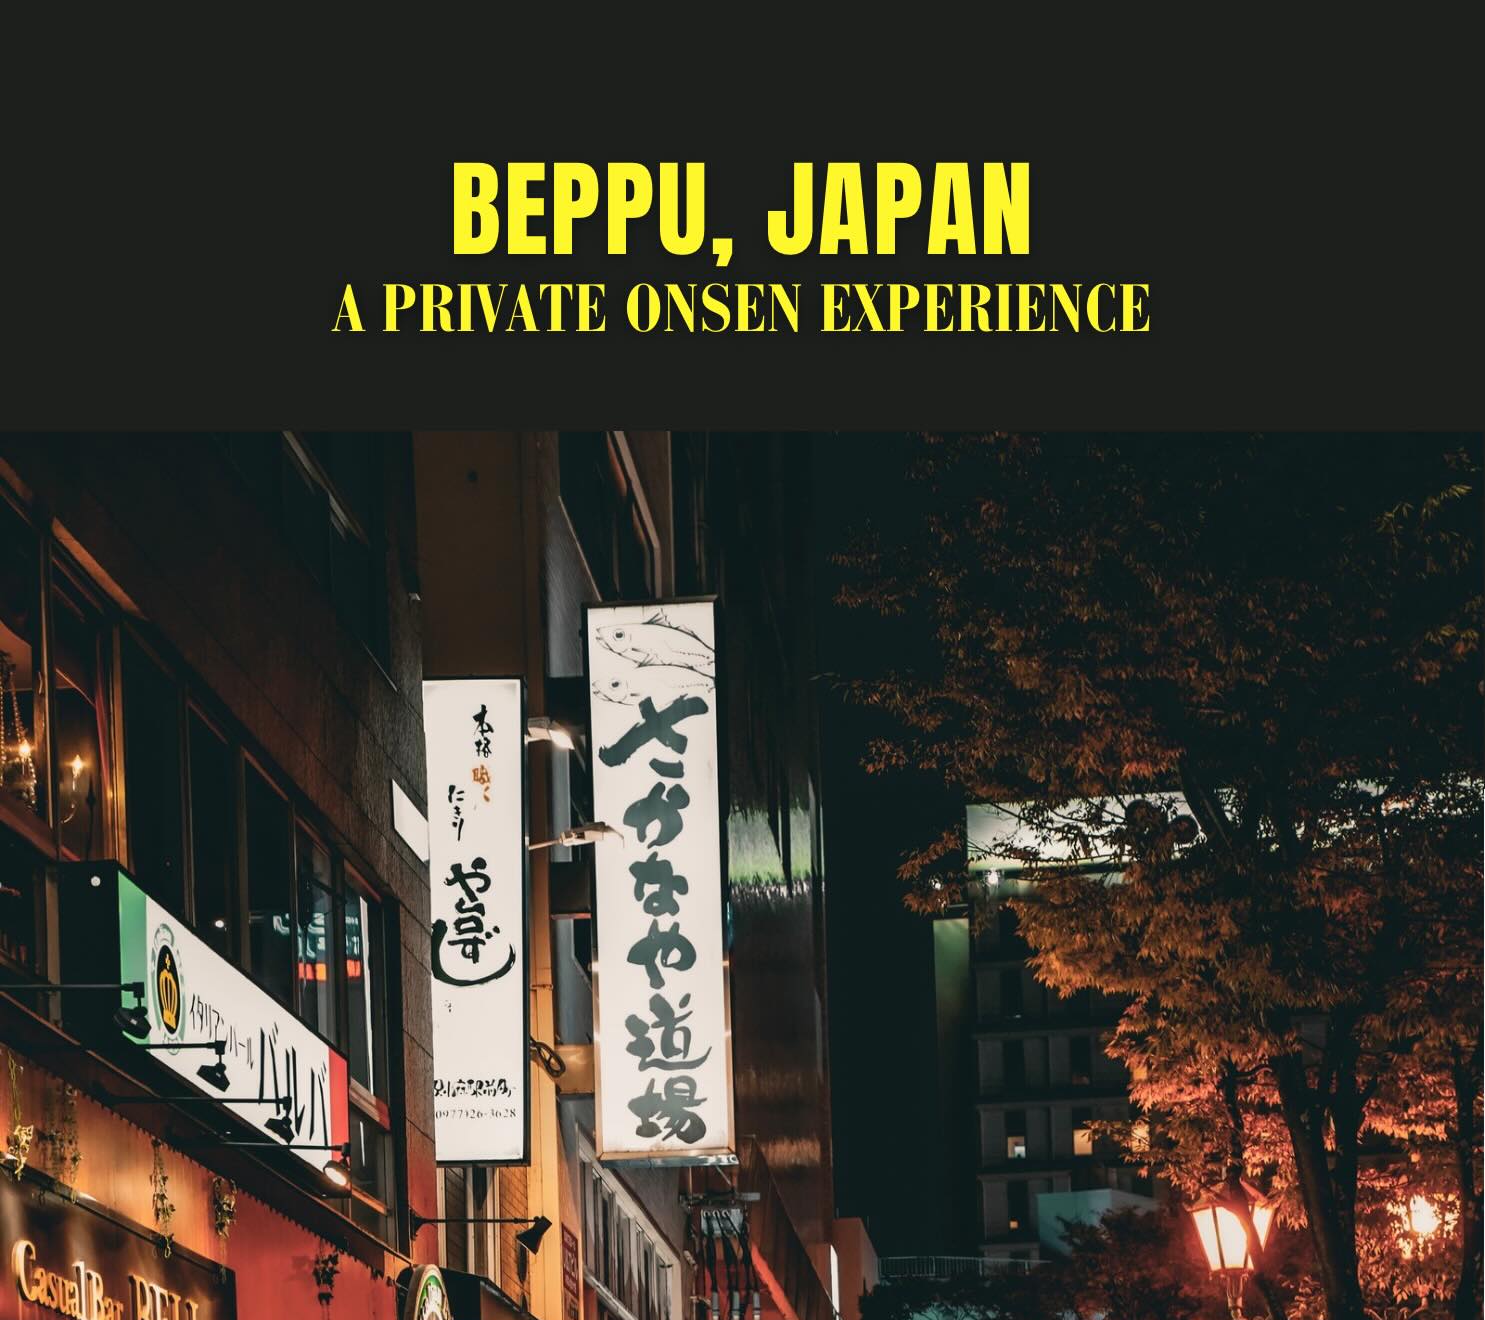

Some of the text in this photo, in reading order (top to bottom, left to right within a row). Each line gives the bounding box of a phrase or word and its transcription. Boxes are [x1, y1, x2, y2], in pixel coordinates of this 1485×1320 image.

[600, 695, 710, 1143] さかなや道場
